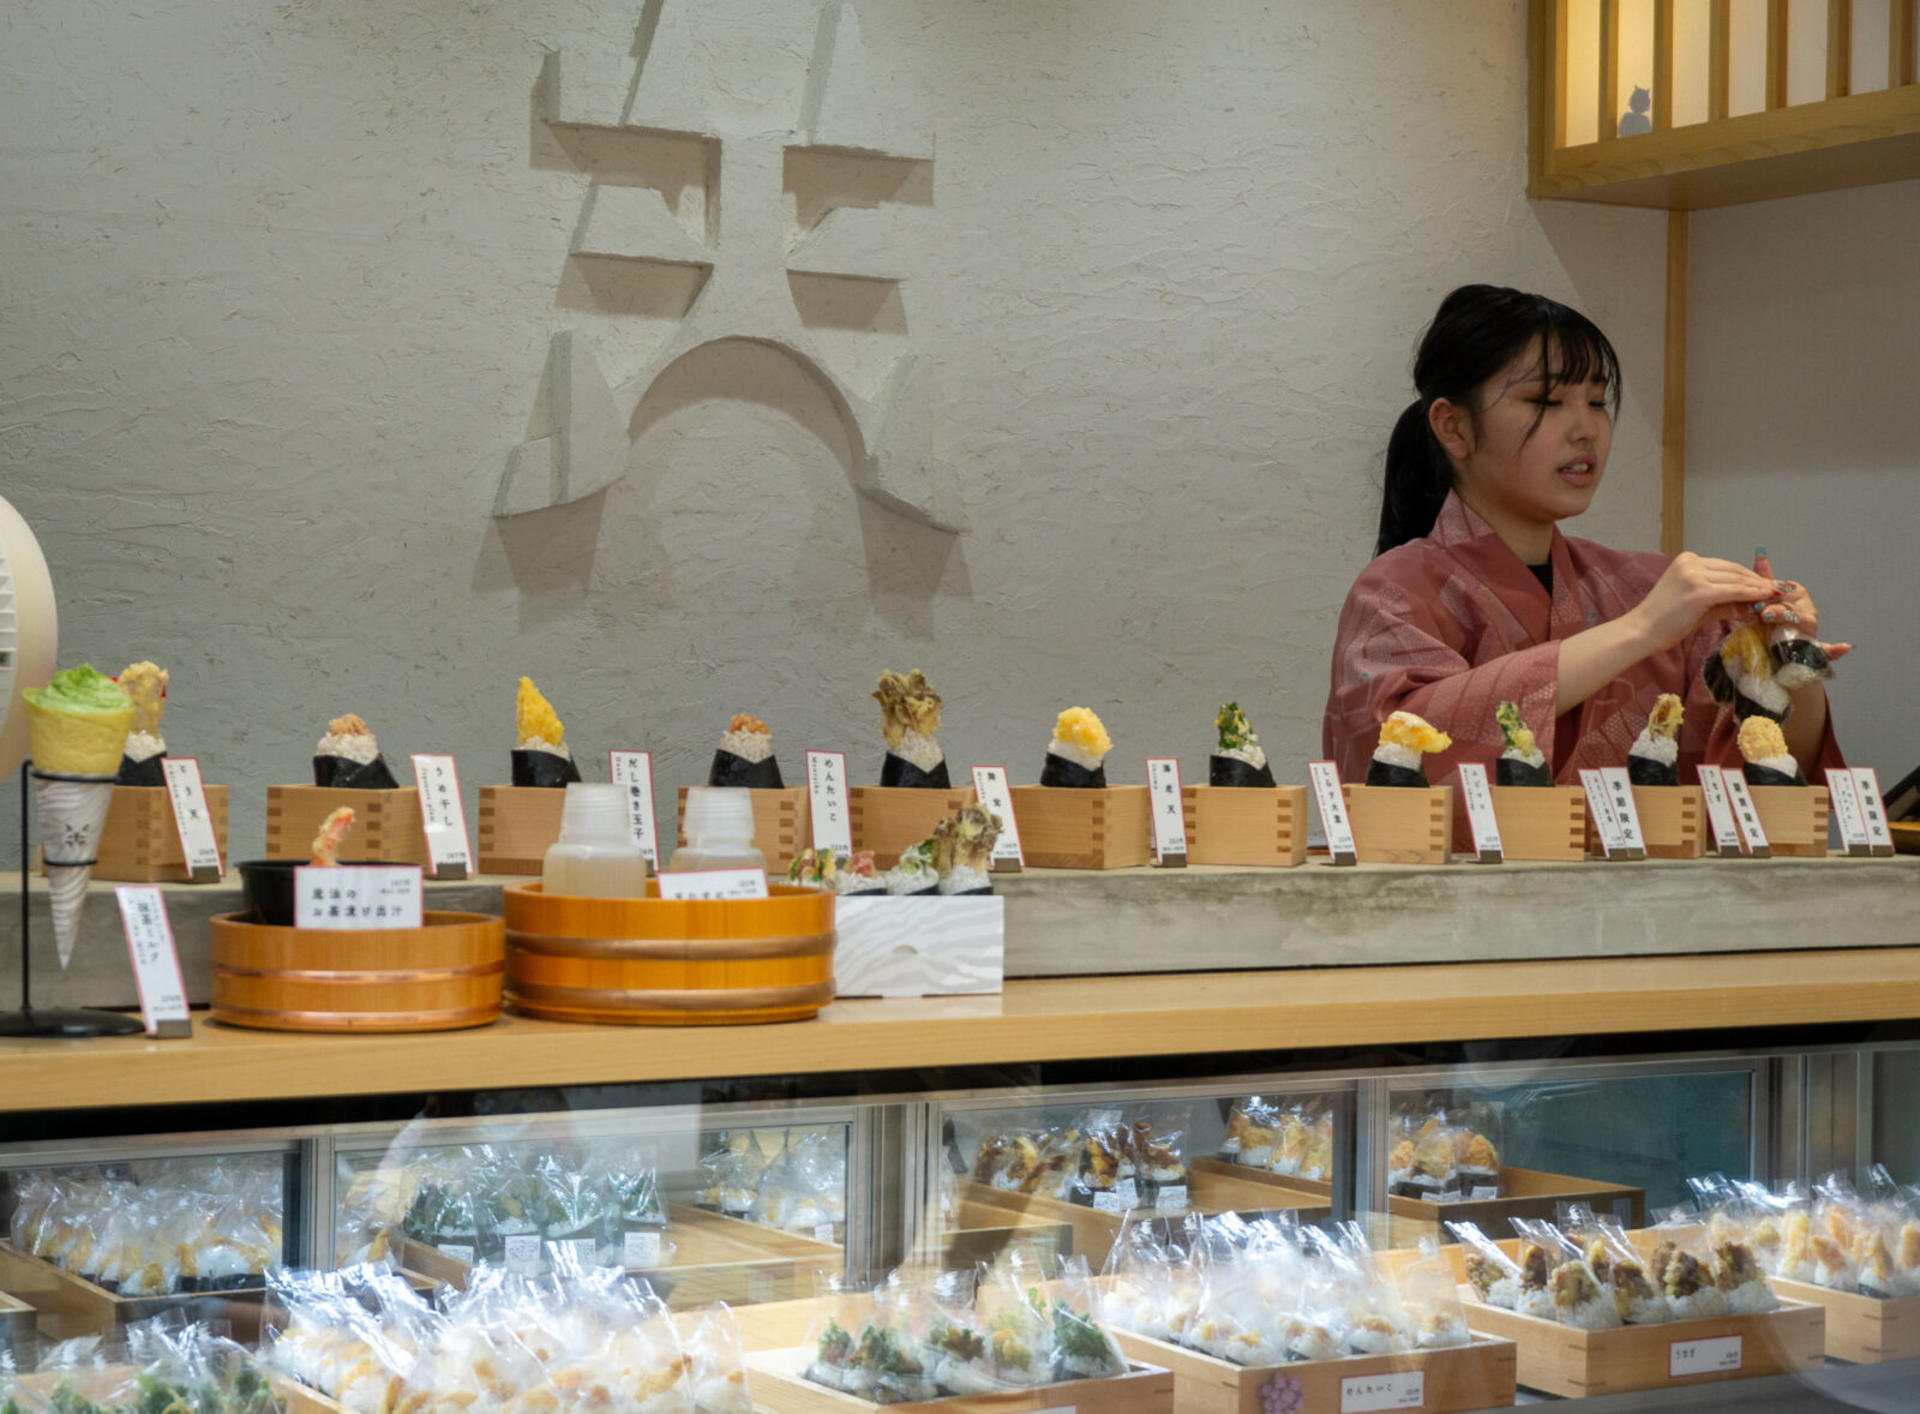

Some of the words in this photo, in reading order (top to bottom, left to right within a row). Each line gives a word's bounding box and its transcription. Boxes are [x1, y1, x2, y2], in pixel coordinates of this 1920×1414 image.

[435, 767, 453, 826] うめ干し
[628, 757, 645, 840] だし巻き玉子
[824, 758, 838, 822] めんたいこ
[1162, 764, 1176, 814] 海老天
[1612, 781, 1634, 840] 季節限定
[1861, 780, 1883, 837] 季節限定
[1345, 1382, 1394, 1397] めんたいこ
